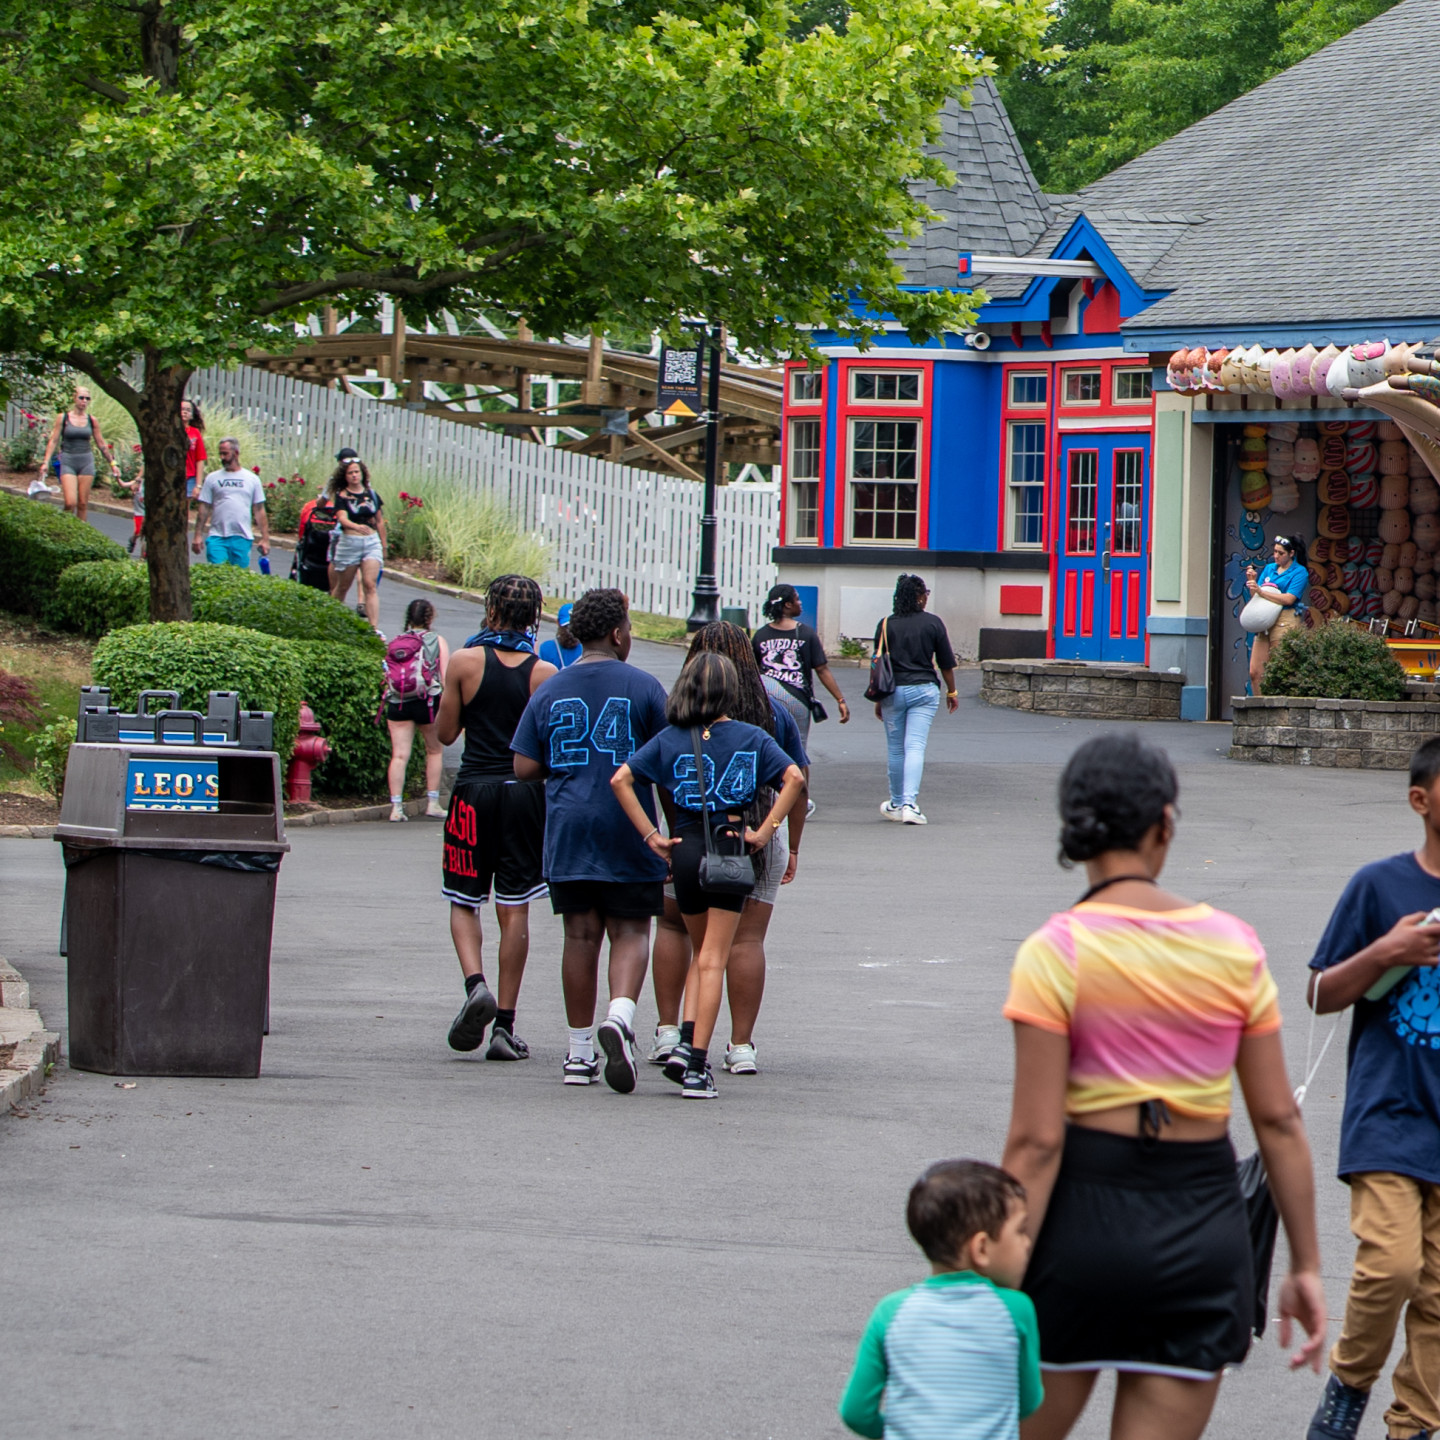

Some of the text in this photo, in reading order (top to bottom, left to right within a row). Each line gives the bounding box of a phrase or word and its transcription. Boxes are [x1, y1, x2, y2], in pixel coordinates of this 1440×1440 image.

[217, 479, 244, 488] VANS
[760, 638, 806, 654] SAVED BY
[549, 697, 636, 767] 24
[134, 772, 219, 797] LEO'S
[673, 751, 757, 812] 24
